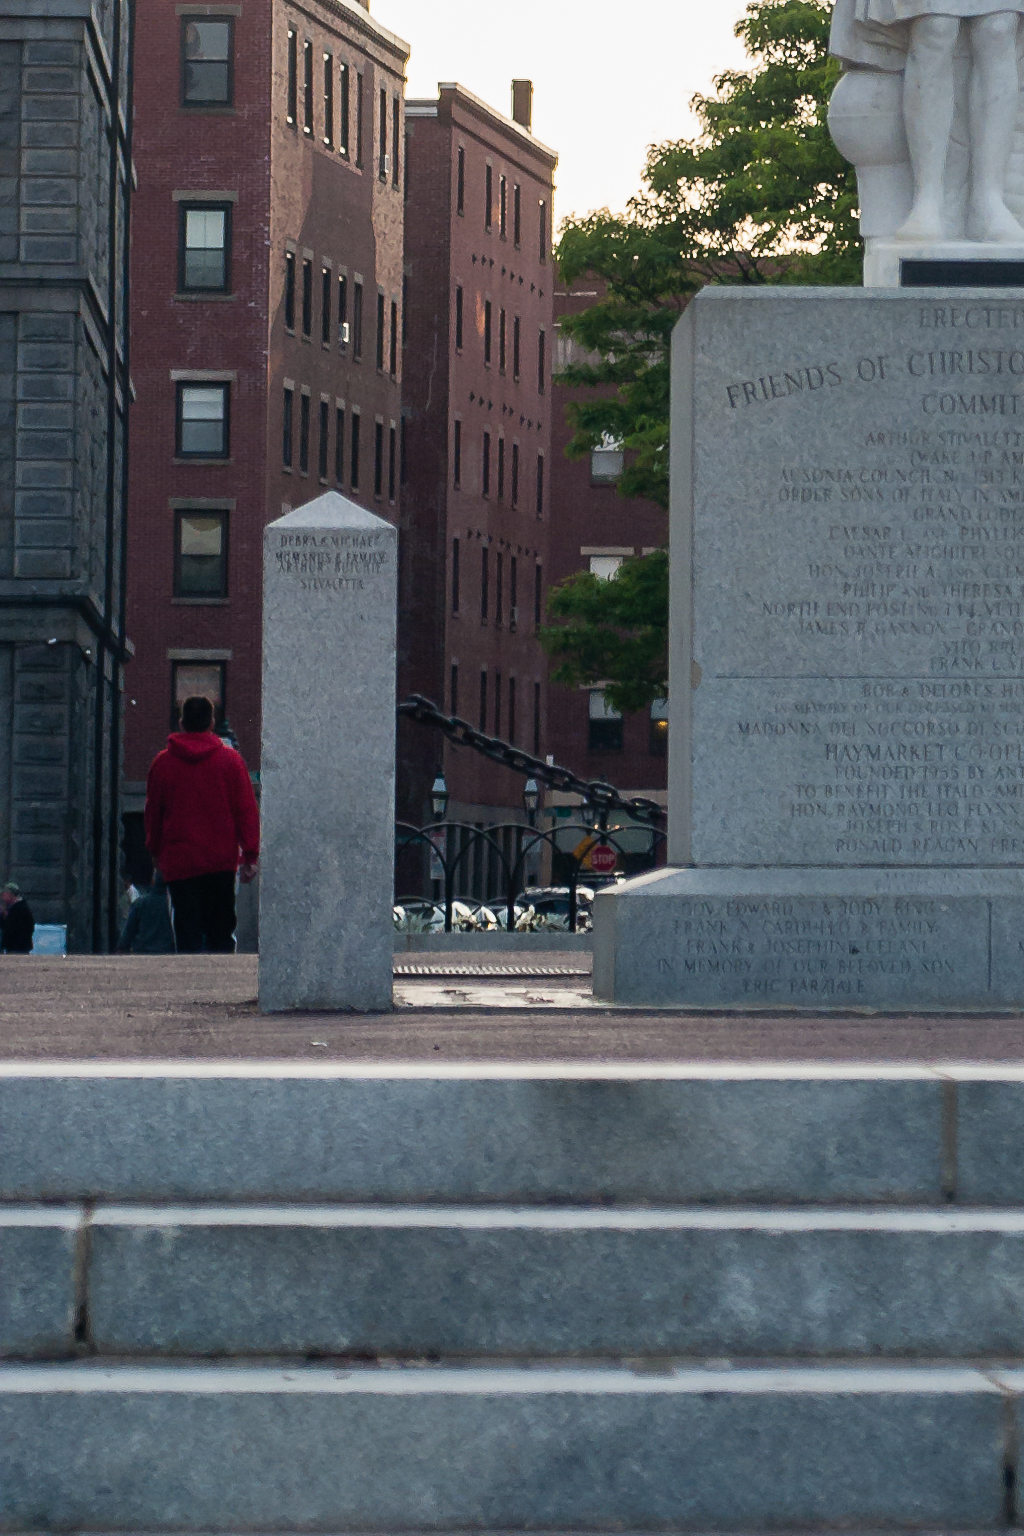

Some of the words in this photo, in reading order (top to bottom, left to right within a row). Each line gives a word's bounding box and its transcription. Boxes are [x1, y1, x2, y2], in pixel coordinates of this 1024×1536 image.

[726, 362, 842, 409] FRIENDS
[856, 355, 890, 382] OF
[865, 431, 931, 447] ARTHUR
[778, 487, 833, 504] ORDER
[840, 487, 884, 504] SONS
[892, 487, 910, 504] OF
[920, 487, 964, 504] ITALY
[972, 487, 990, 504] IN
[912, 506, 973, 523] GRAND
[280, 535, 318, 548] DEBRA
[330, 535, 381, 548] MICHAEL
[844, 544, 898, 561] DANTE
[278, 562, 325, 574] ARTHUR
[842, 582, 899, 599] PHILIP
[941, 582, 1013, 599] THERESA
[762, 601, 820, 618] NORTH
[826, 601, 861, 618] END
[799, 620, 852, 638] JAMES
[966, 620, 1023, 638] GRAND
[929, 657, 986, 672] FRANK
[861, 681, 897, 699] BOB
[737, 720, 824, 738] MADONNA
[828, 720, 859, 738] DEL
[866, 720, 961, 738] SOCCORSO
[967, 720, 985, 738] DI
[824, 742, 948, 763] HAYMARKET
[833, 764, 917, 781] FOUNDED
[967, 764, 986, 781] BY
[794, 783, 818, 800] TO
[823, 783, 889, 800] BENEFIT
[894, 783, 929, 800] THE
[837, 801, 920, 819] RAYMOND
[925, 801, 960, 819] LEO
[846, 819, 908, 835] JOSEPH
[929, 819, 973, 835] ROSE
[834, 837, 903, 854] RONALD
[910, 837, 979, 854] REAGAN
[592, 854, 616, 865] STOP
[724, 900, 796, 917] EDWARD
[673, 918, 728, 936] FRANK
[877, 918, 939, 936] FAMILY
[686, 939, 742, 955] FRANK
[657, 958, 674, 975] IN
[684, 958, 753, 975] MEMORY
[762, 958, 786, 975] OF
[793, 958, 830, 975] OUR
[837, 958, 912, 975] BELOVED
[742, 978, 782, 995] ERIC
